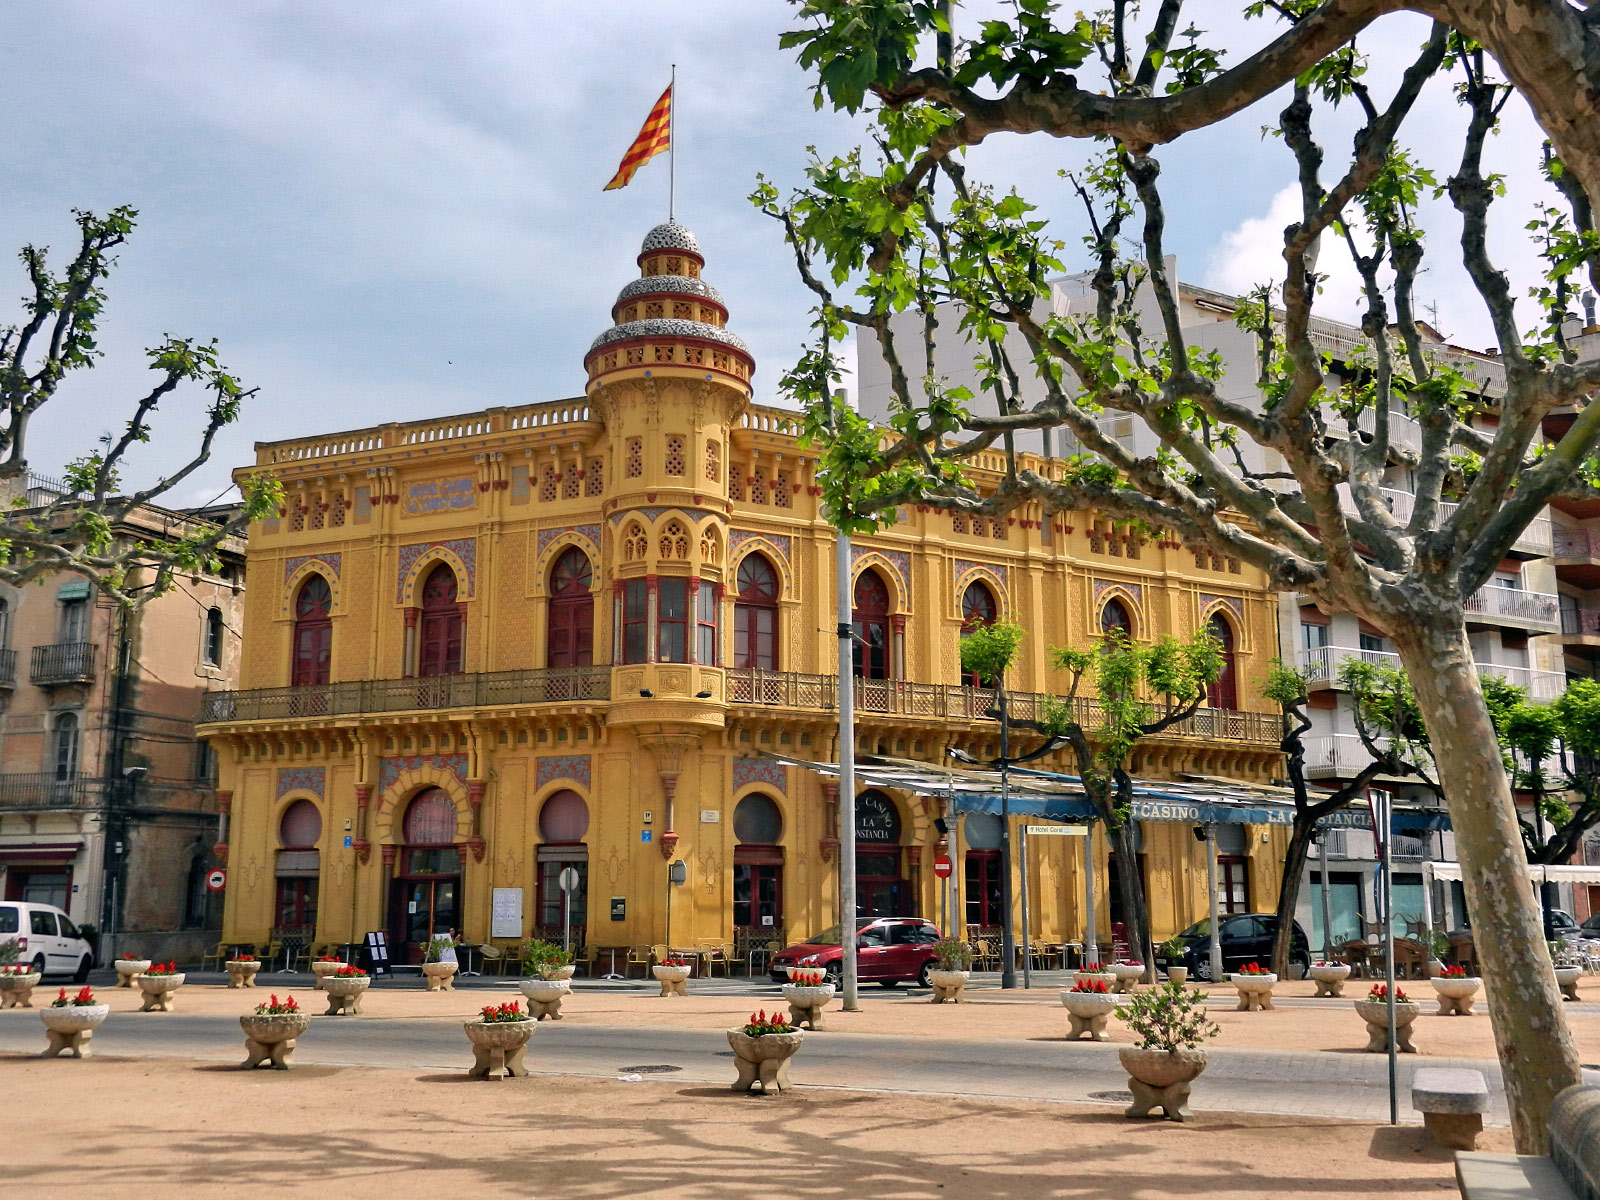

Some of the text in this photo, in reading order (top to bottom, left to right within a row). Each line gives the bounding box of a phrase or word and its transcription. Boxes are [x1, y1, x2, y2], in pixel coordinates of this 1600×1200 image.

[865, 797, 893, 828] CASINO
[1140, 805, 1199, 820] CASINO
[1267, 810, 1286, 823] LA
[863, 818, 875, 827] LA
[855, 830, 889, 839] NSTANCIA
